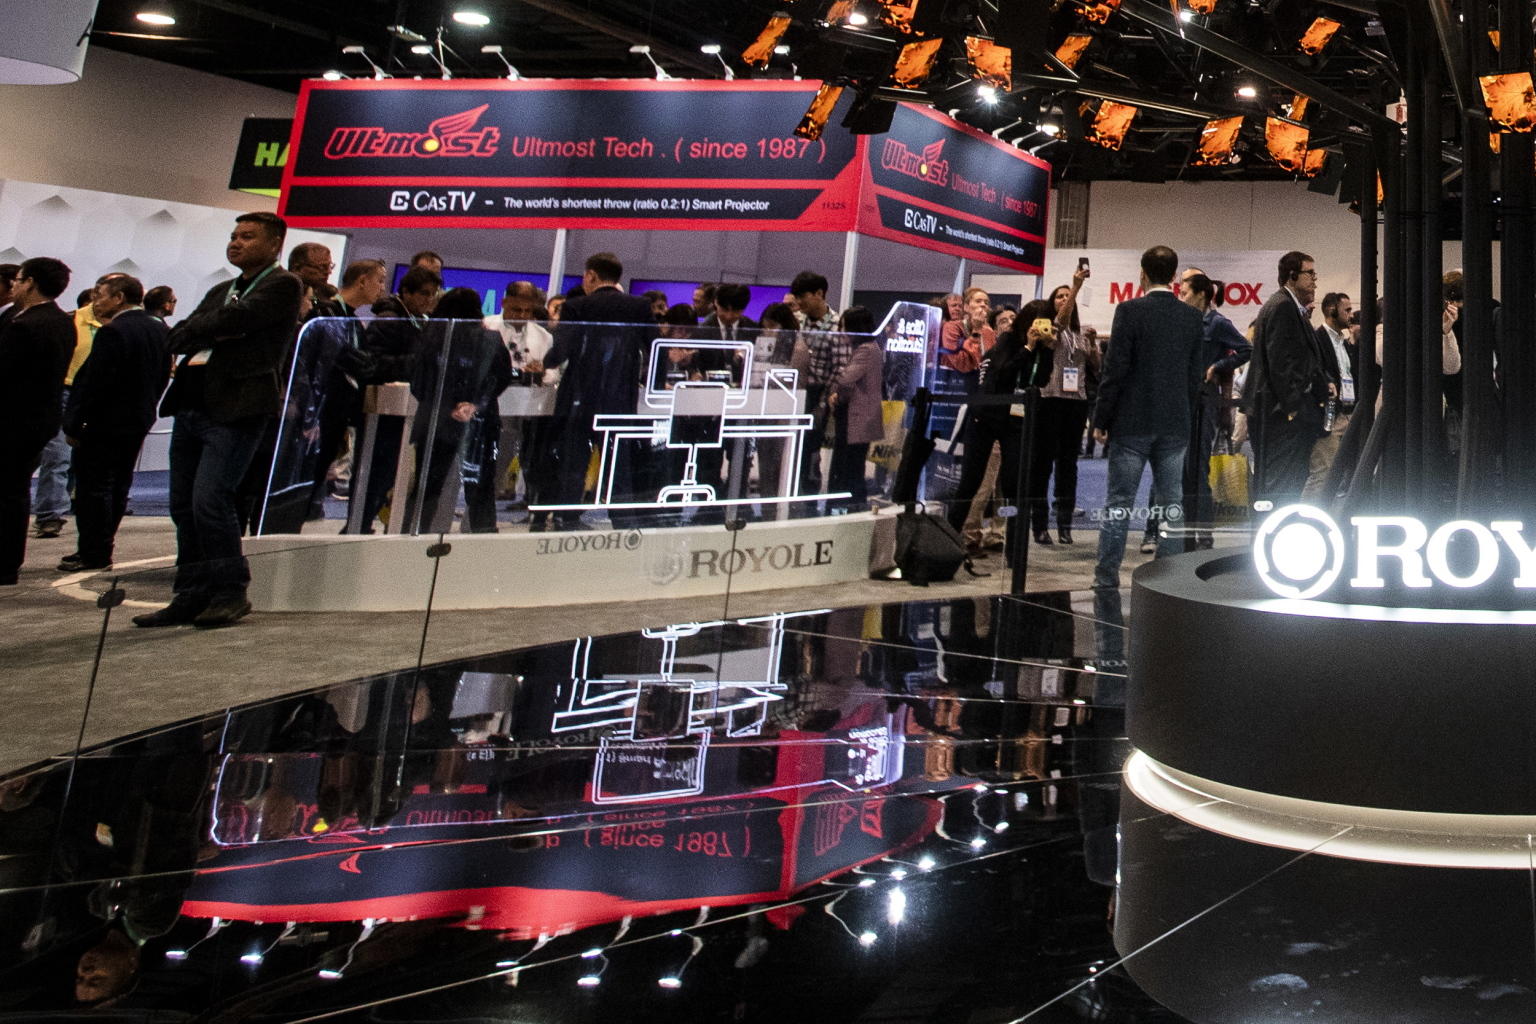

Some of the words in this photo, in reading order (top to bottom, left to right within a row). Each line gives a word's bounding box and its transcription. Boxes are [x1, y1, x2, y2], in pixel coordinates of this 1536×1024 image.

[325, 121, 500, 158] Ultmost
[512, 136, 595, 158] Ultmost
[603, 137, 653, 158] Tech
[689, 137, 747, 158] since
[757, 138, 808, 159] 1987
[504, 197, 522, 208] The
[525, 198, 559, 208] world's
[562, 198, 601, 208] shortest
[604, 198, 631, 208] throw
[633, 199, 659, 211] (ratio
[692, 198, 722, 210] Smart
[724, 199, 770, 212] Projector
[688, 540, 834, 578] ROYOLE
